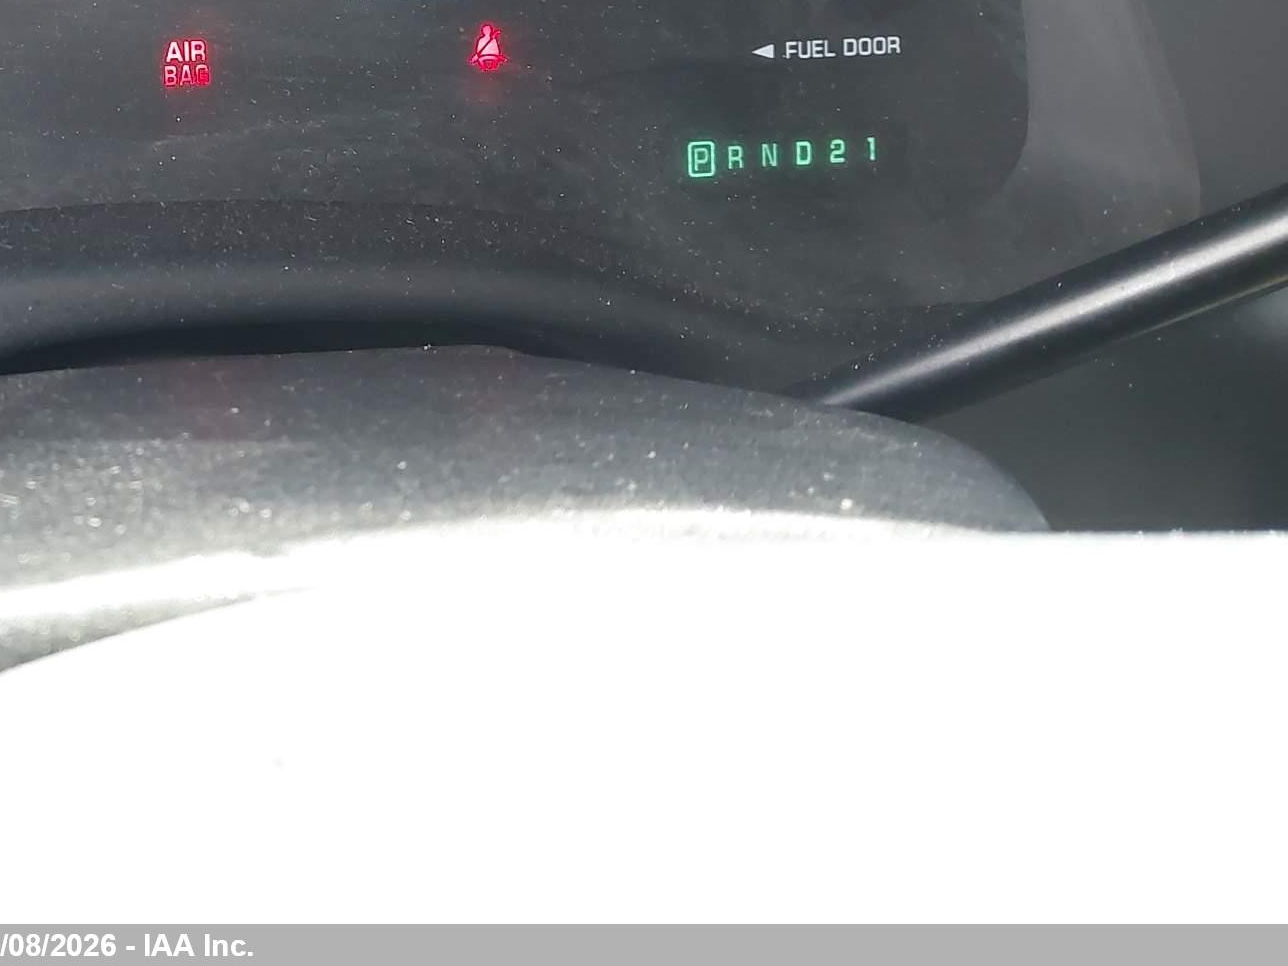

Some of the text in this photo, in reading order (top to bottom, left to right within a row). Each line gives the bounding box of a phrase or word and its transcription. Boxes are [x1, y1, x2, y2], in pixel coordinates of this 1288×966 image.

[166, 40, 206, 62] AIR
[786, 36, 901, 59] FUEL DOOR
[164, 64, 210, 86] BAG
[694, 137, 876, 171] P R N D 2 1
